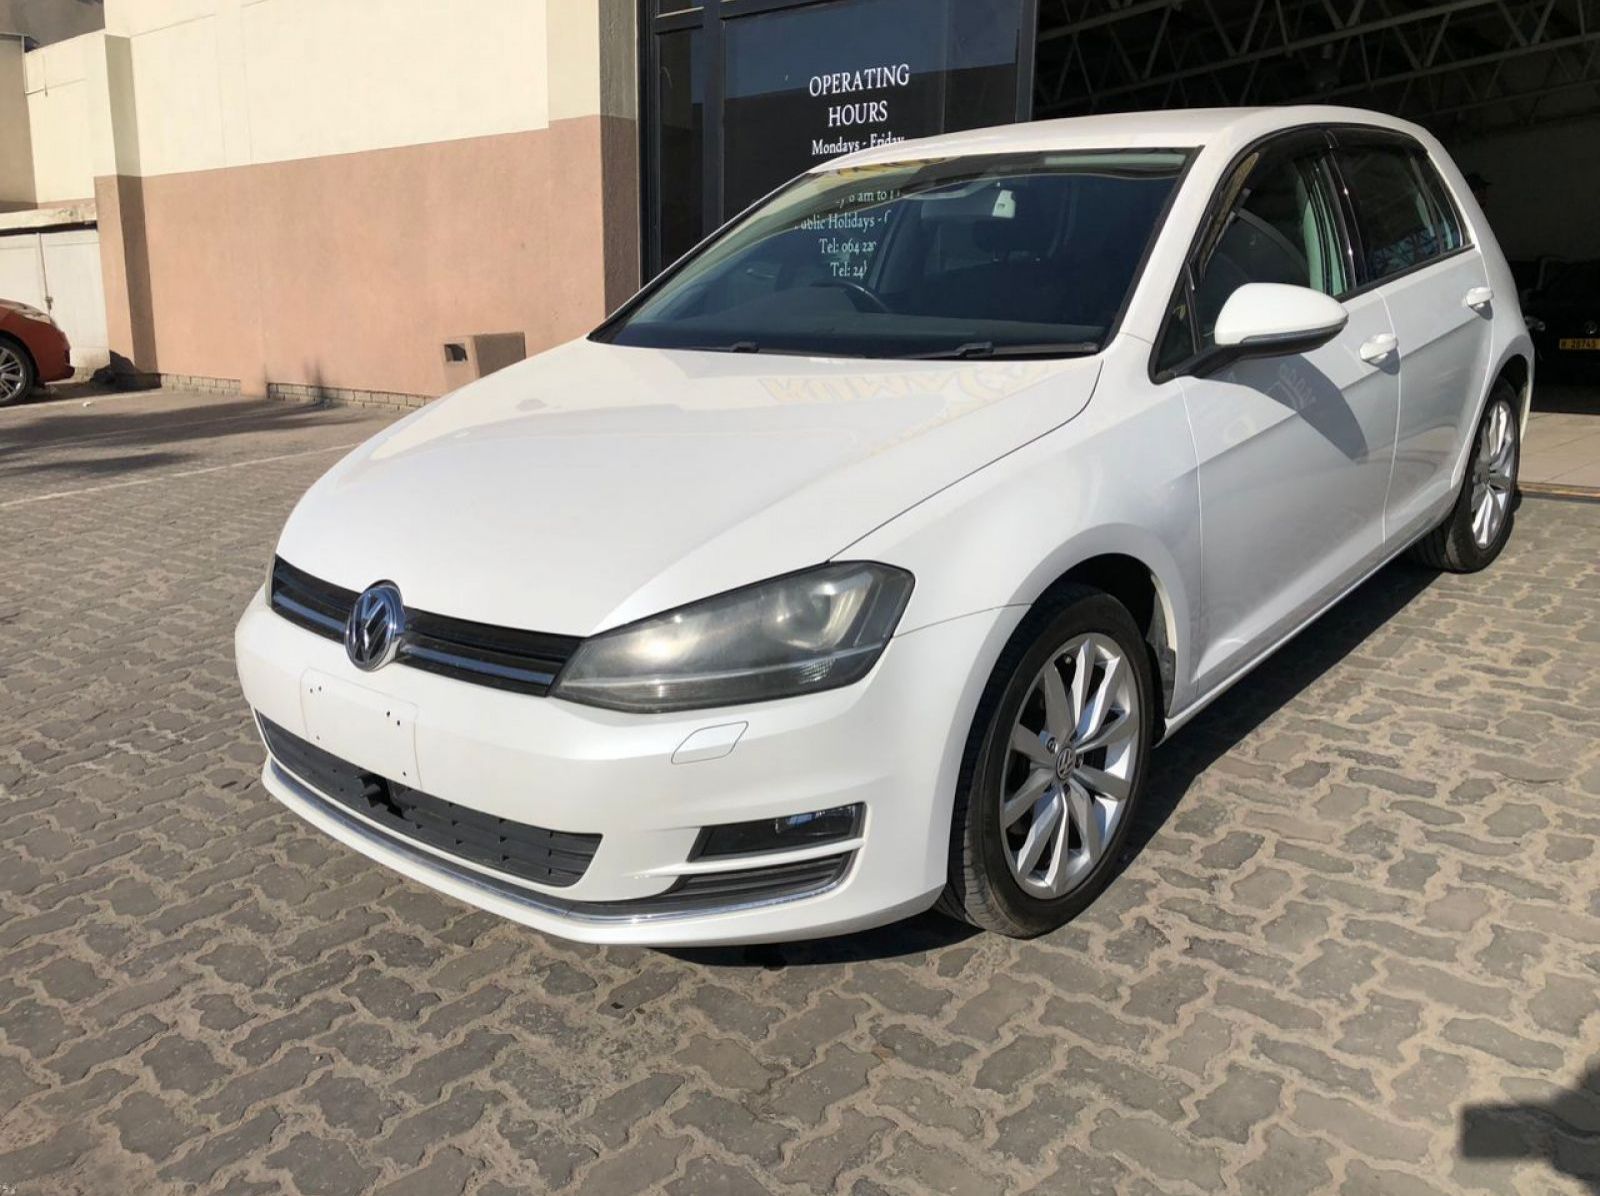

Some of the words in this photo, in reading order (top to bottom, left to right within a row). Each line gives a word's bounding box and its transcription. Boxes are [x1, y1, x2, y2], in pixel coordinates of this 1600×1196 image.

[809, 63, 910, 97] OPERATING
[828, 100, 888, 127] HOURS
[811, 136, 860, 155] Mondays
[794, 212, 826, 230] ublic
[828, 211, 875, 233] Holidays
[818, 237, 839, 255] Tel:
[841, 238, 860, 255] 064
[830, 261, 851, 277] Tel:
